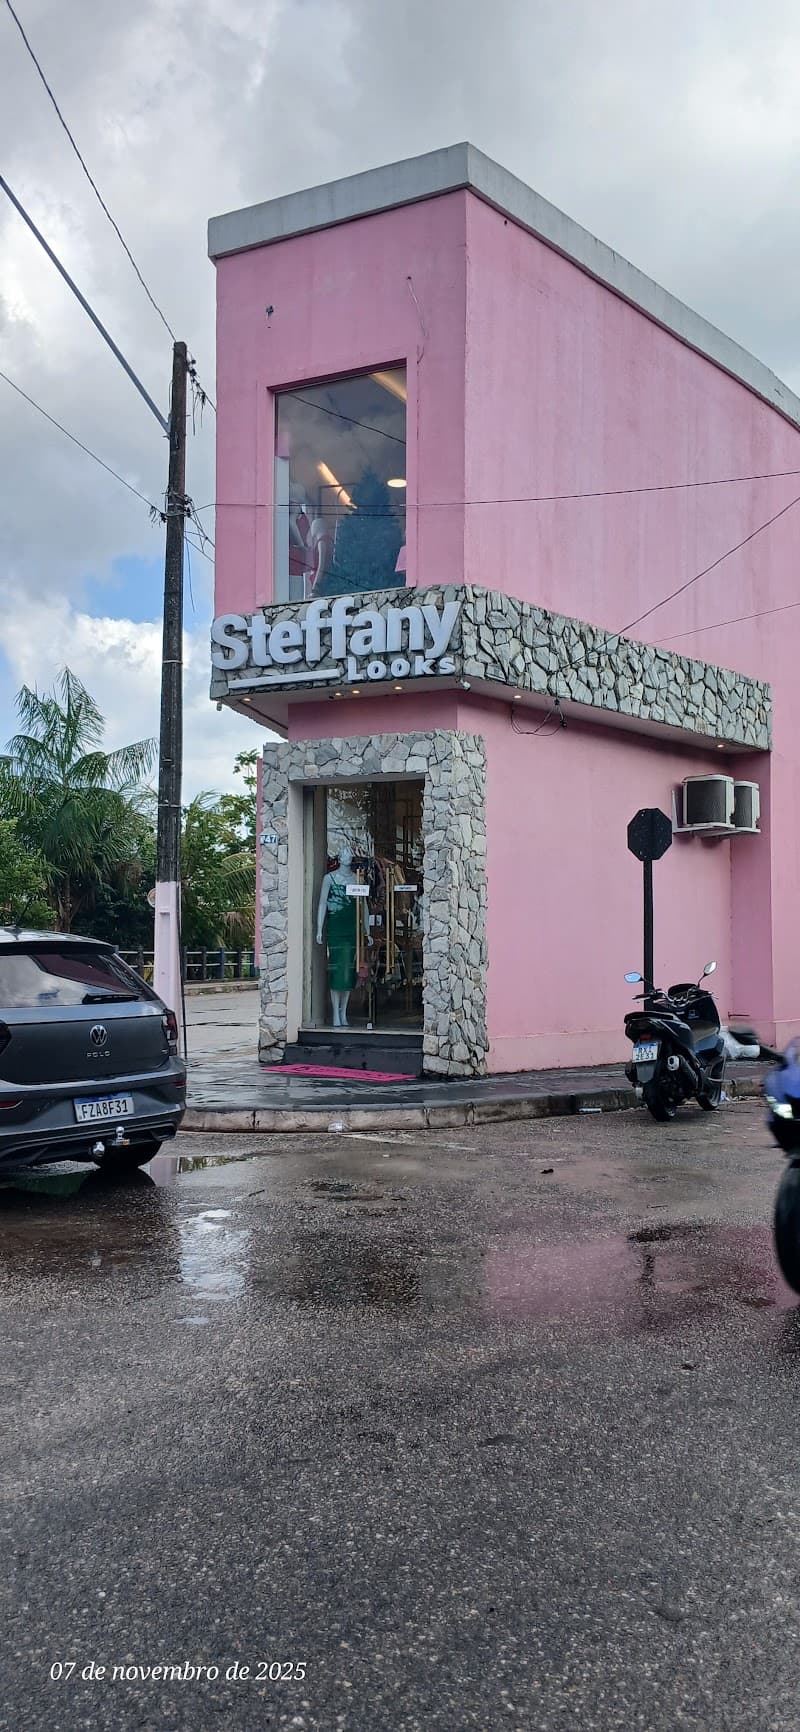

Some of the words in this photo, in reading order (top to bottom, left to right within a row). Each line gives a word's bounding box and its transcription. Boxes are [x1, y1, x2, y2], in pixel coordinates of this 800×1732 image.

[210, 596, 461, 670] Steffany
[347, 655, 457, 681] Looks
[81, 1099, 128, 1119] FZA8F31
